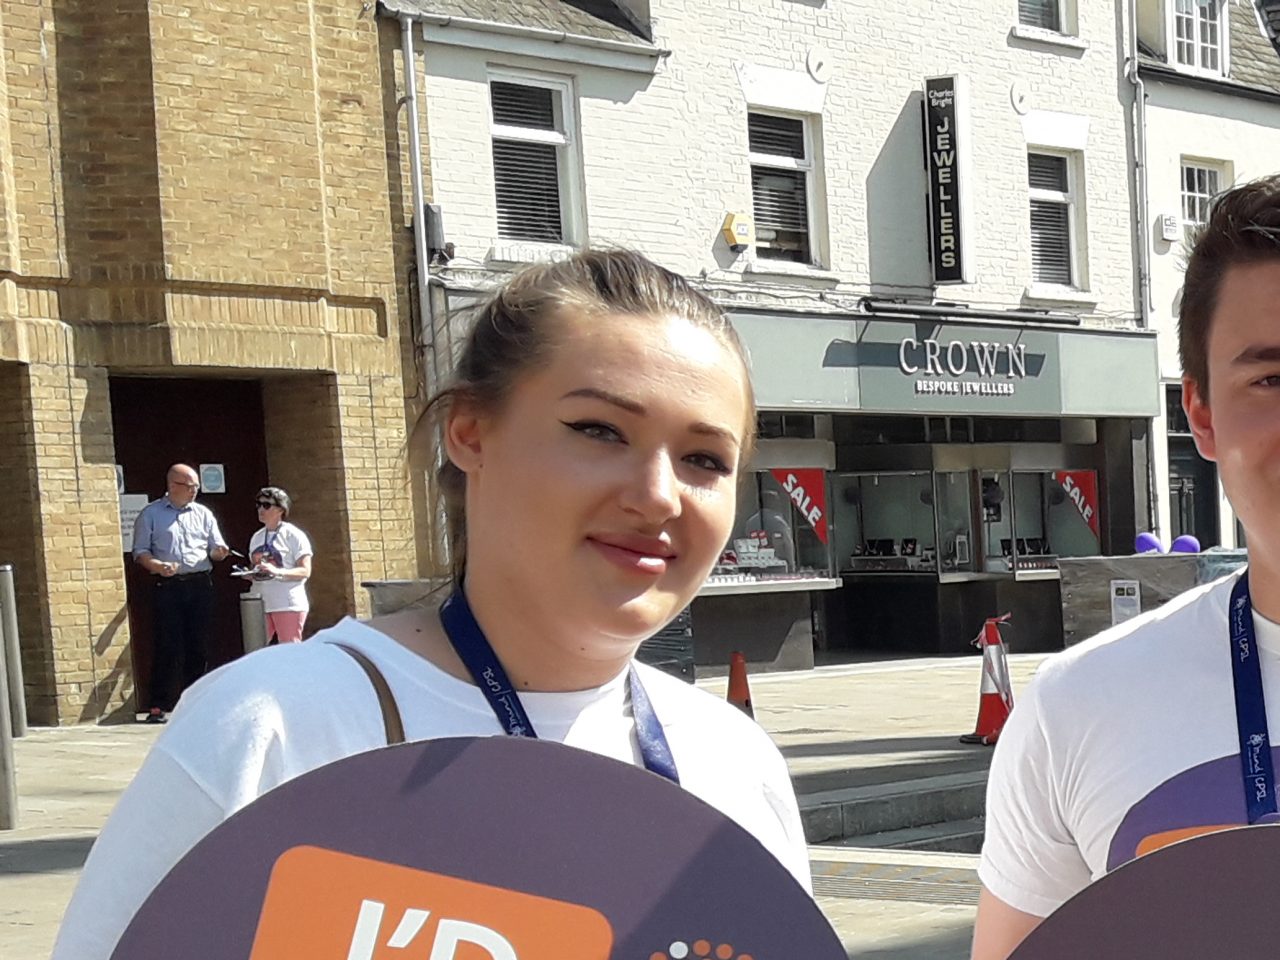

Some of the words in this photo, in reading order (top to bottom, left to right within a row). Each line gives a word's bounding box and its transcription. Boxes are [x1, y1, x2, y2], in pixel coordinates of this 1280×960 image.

[932, 116, 956, 268] JEWELLERS
[899, 337, 1026, 378] CROWN
[915, 379, 959, 393] BESPOKE
[961, 380, 1015, 395] JEWELLERS
[782, 473, 823, 528] SALE
[1061, 475, 1094, 523] SALE
